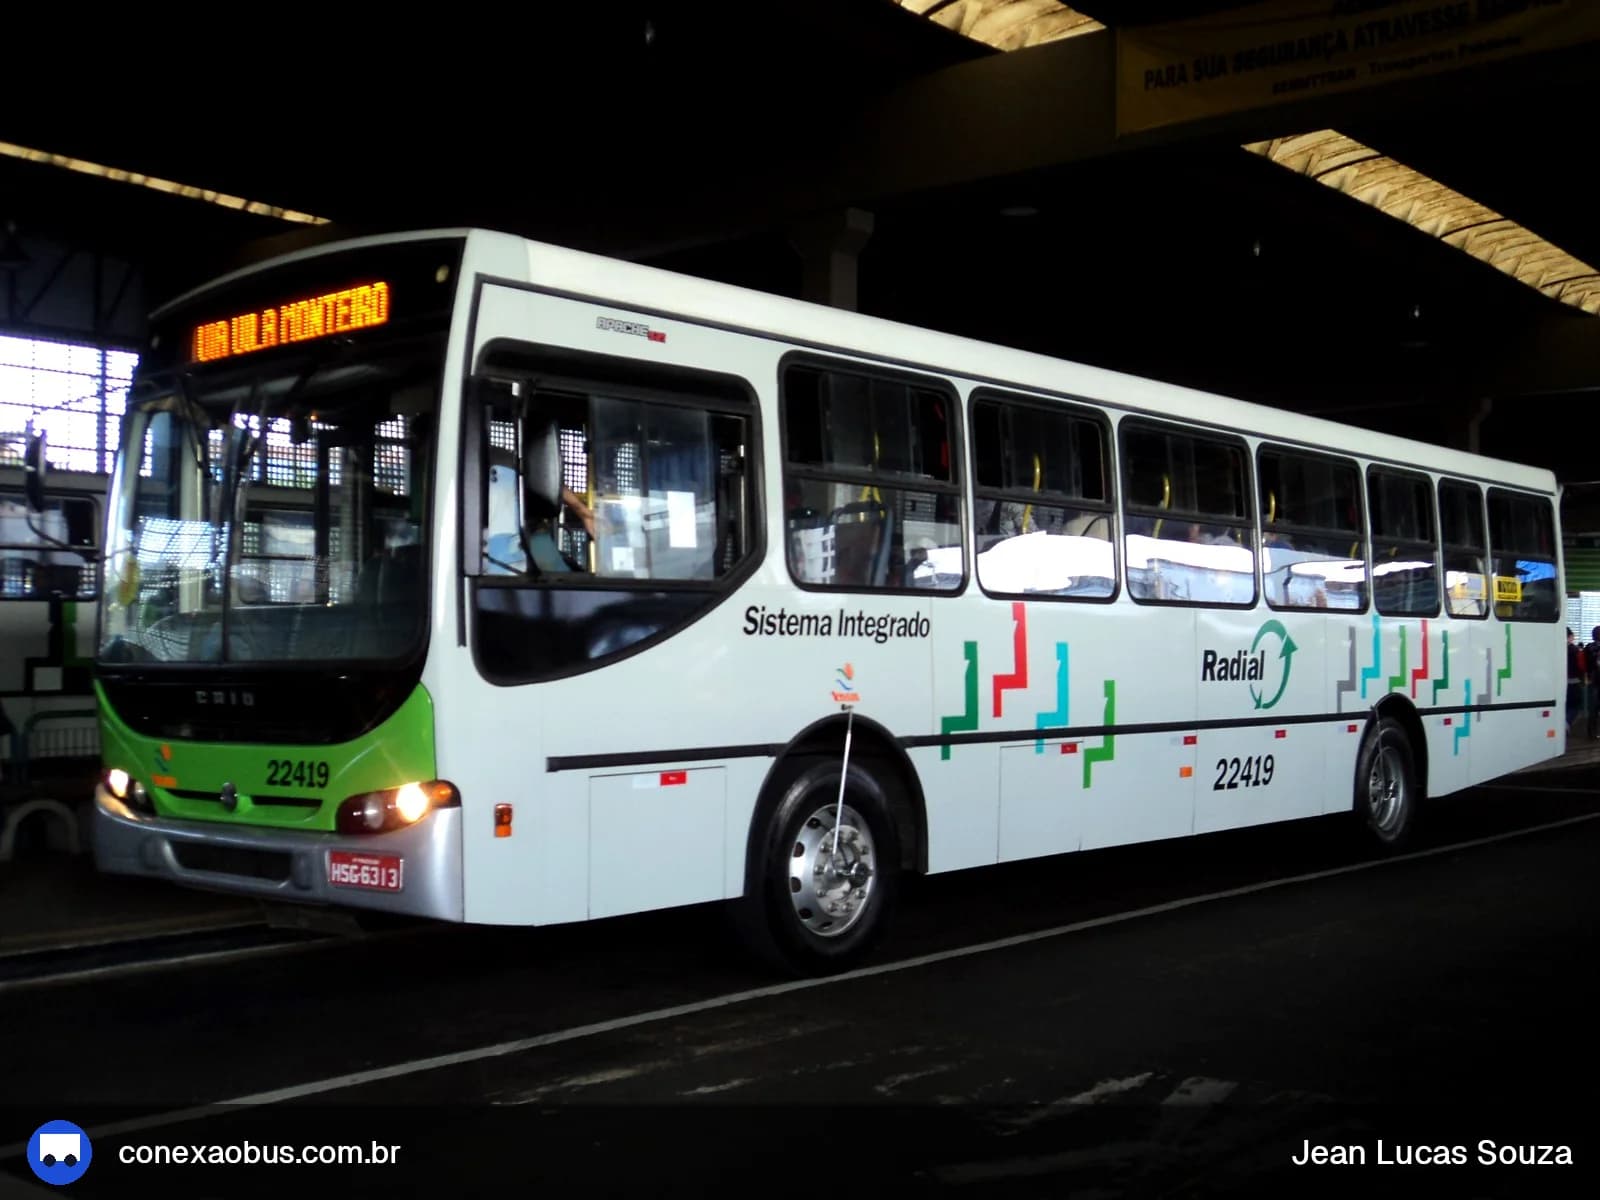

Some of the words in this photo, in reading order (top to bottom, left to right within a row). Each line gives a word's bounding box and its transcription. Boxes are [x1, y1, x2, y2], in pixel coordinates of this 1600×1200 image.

[1144, 64, 1188, 92] PARA
[1193, 53, 1229, 82] SUA
[279, 281, 389, 344] MONTEIRO
[596, 316, 650, 337] APACHE
[743, 605, 832, 637] Sistema
[837, 609, 931, 644] Integrado
[1201, 649, 1265, 681] Radial
[266, 759, 330, 788] 22419
[1213, 754, 1276, 791] 22419
